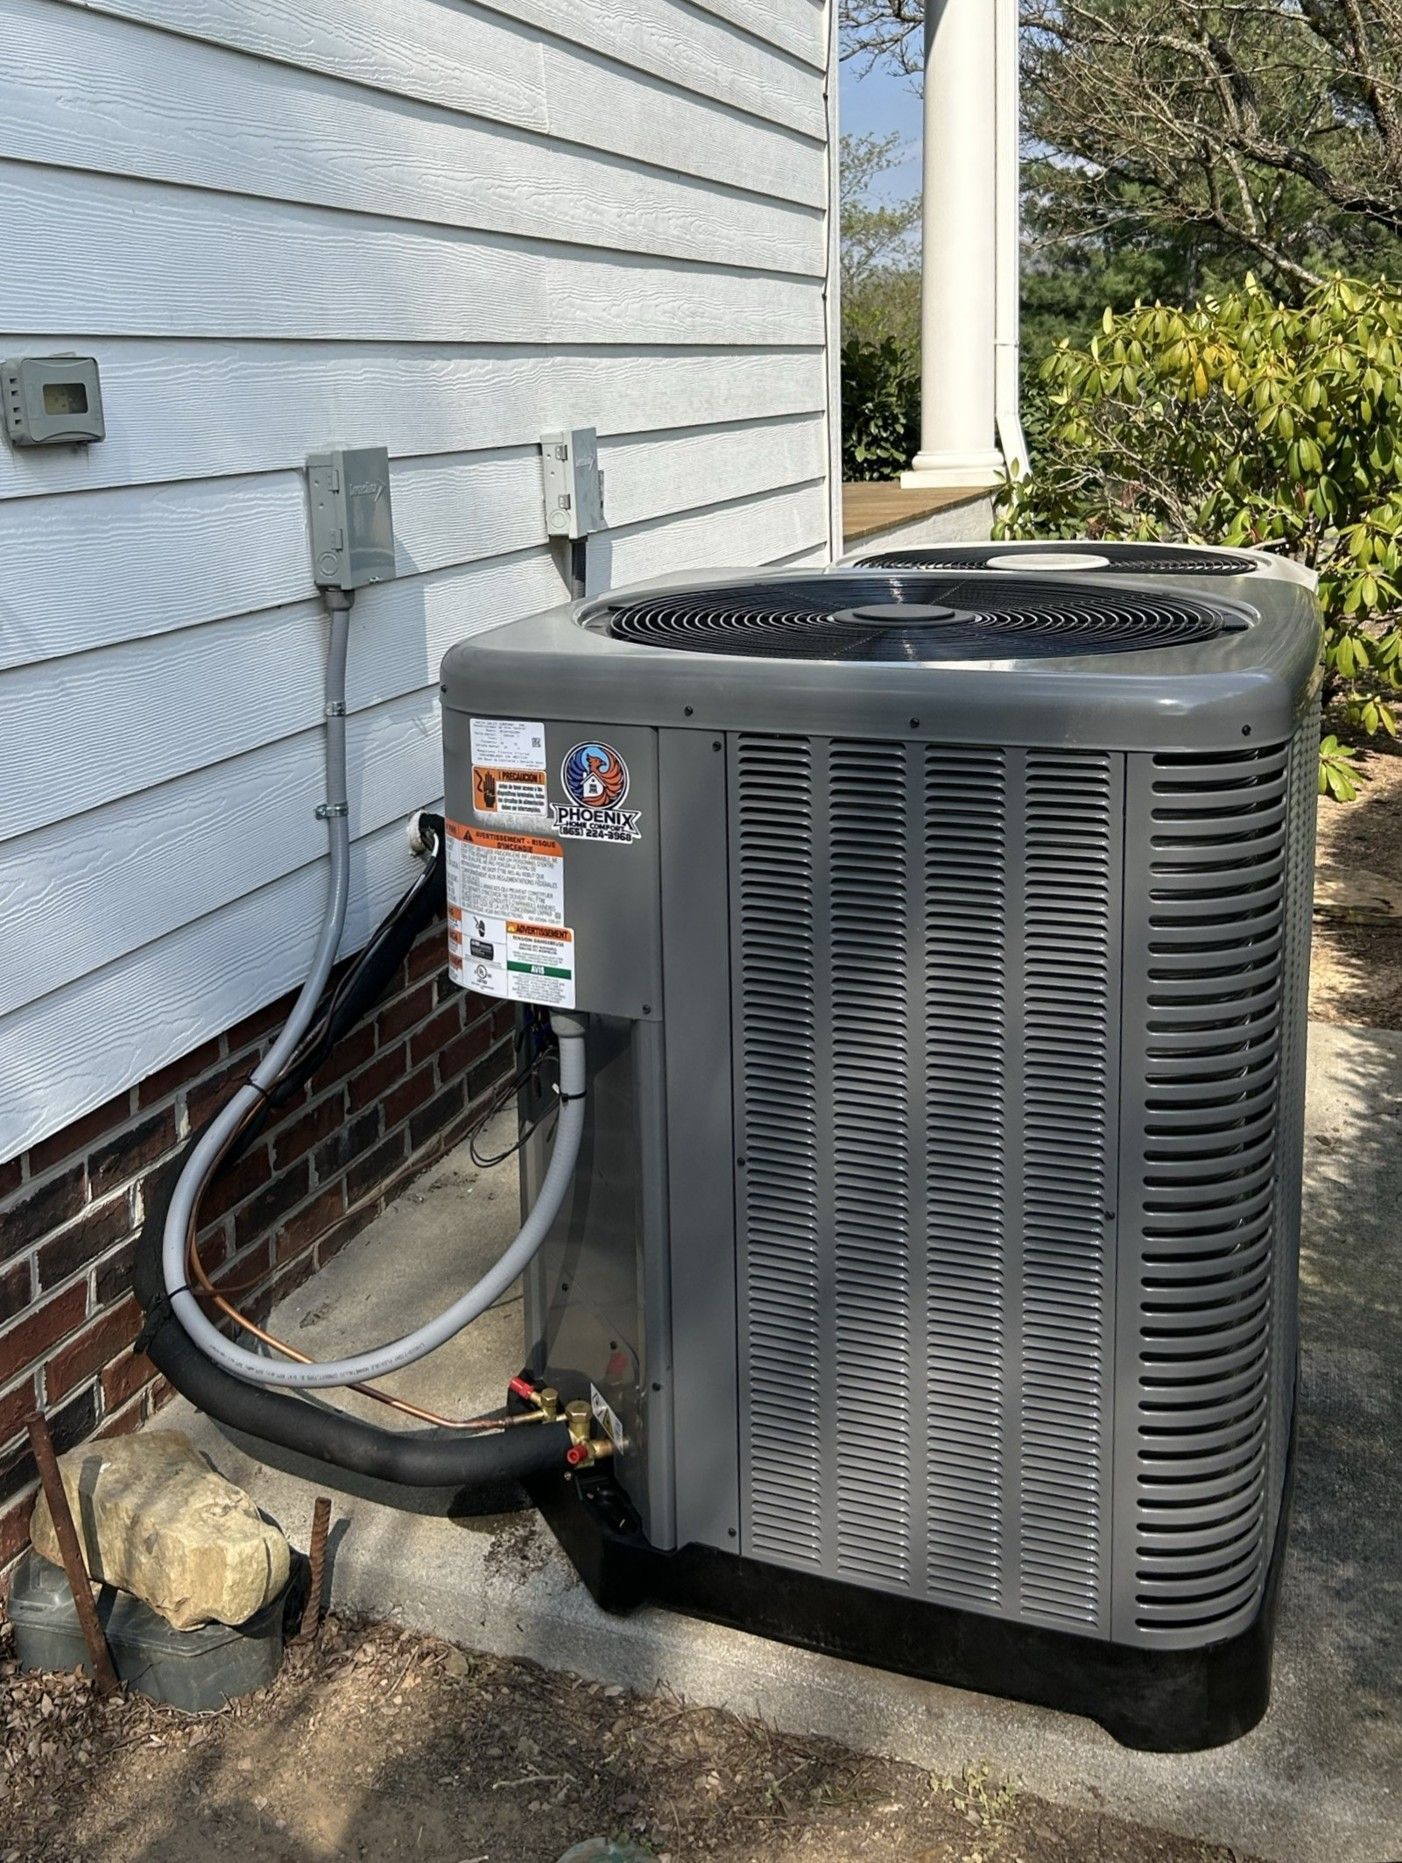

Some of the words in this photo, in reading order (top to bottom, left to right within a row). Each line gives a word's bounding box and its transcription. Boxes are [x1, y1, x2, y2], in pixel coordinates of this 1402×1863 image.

[558, 808, 634, 830] PHOENIX
[590, 823, 625, 831] COMFORT
[560, 827, 584, 836] (865)
[532, 840, 556, 848] RISQUE
